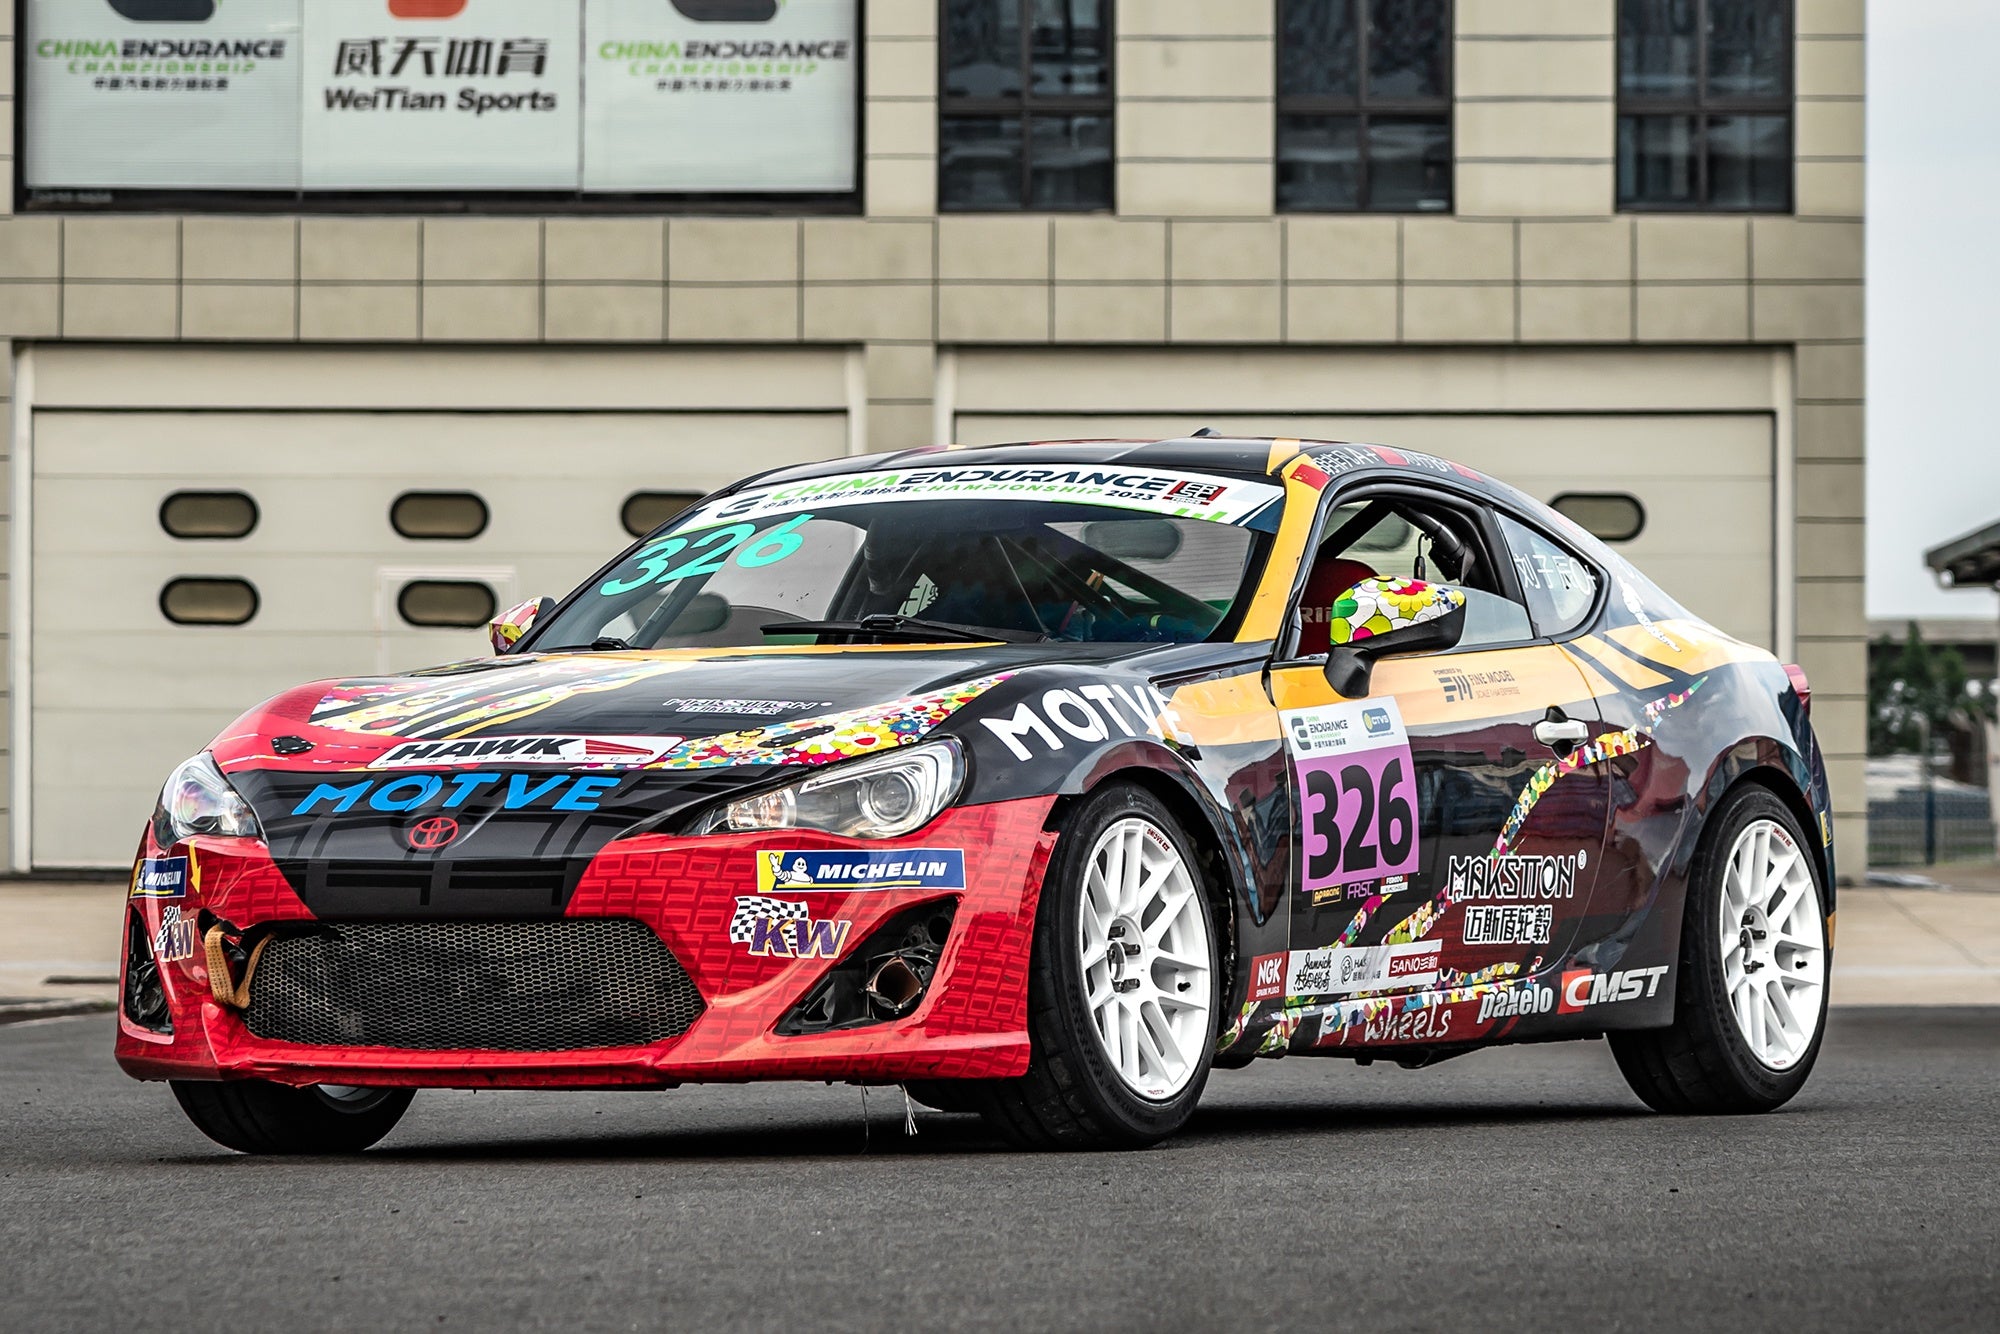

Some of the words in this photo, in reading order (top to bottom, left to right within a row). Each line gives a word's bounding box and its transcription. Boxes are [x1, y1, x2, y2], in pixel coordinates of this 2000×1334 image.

[37, 39, 118, 58] CHINA
[121, 39, 287, 59] ENDURANCE
[333, 36, 550, 76] 威天体育
[598, 39, 682, 60] CHINA
[684, 40, 850, 60] ENDURANCE
[67, 61, 256, 73] CHAMPIONSHIP
[627, 61, 818, 76] CHAMPIONSHIP
[324, 86, 447, 110] WeiTian
[456, 87, 559, 116] Sports
[771, 474, 901, 501] CHINA
[899, 469, 1178, 492] ENDURANCE
[911, 484, 1103, 495] CHAMPIONSHIP
[1104, 489, 1156, 501] 2023
[600, 513, 815, 596] 326
[1468, 672, 1487, 686] FINE
[1486, 669, 1516, 684] MODEL
[979, 683, 1197, 762] MOTVE
[1308, 719, 1349, 734] ENDURANCE
[378, 756, 649, 767] PERFORMANCE
[386, 738, 583, 761] HAWK
[291, 772, 622, 815] MOTVE
[1305, 757, 1413, 880] 326
[144, 870, 182, 887] MICHELIN
[816, 861, 948, 879] MICHELIN
[748, 916, 853, 959] KW
[1464, 905, 1553, 944] 迈斯盾轮毂
[160, 918, 197, 963] KW
[1257, 957, 1283, 987] NGK
[1255, 986, 1268, 998] SPARK
[1267, 985, 1281, 997] PLUGS
[1565, 965, 1670, 1007] CMST
[1476, 983, 1554, 1024] pakelo
